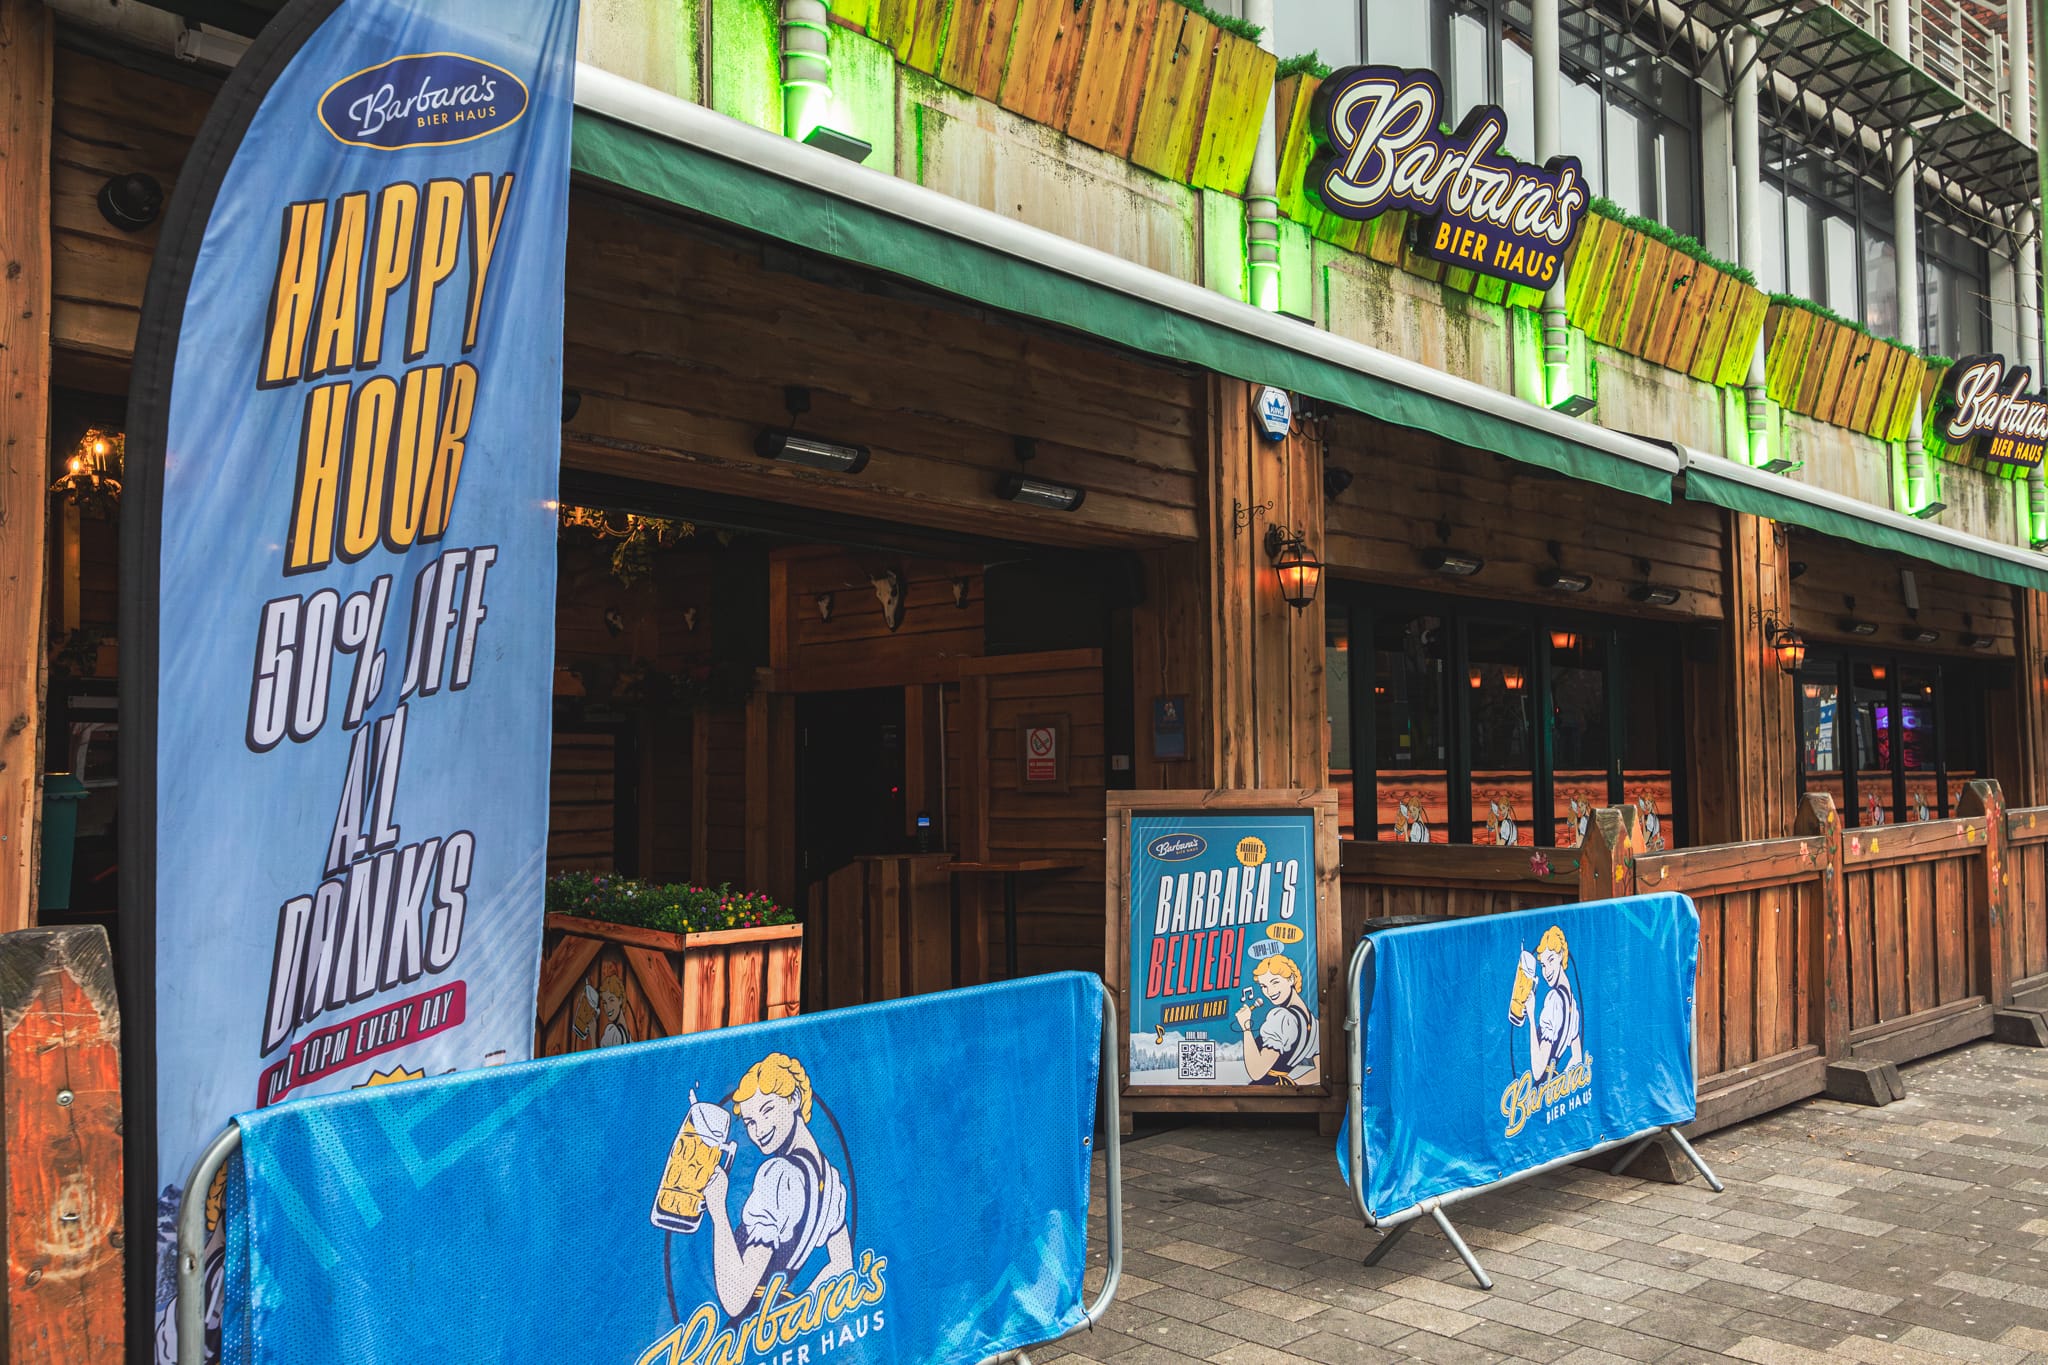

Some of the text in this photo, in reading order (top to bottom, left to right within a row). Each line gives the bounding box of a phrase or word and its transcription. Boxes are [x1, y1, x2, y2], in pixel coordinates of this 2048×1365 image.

[349, 75, 497, 136] Barbara's
[417, 106, 497, 128] BIER HAUS
[1326, 79, 1583, 244] Barbara's
[257, 172, 515, 390] HAPPY
[1435, 222, 1558, 281] BIER HAUS
[1947, 361, 2048, 440] Barbara
[283, 361, 478, 576] HOUR
[1990, 437, 2043, 463] BIER HAUS
[245, 574, 393, 753] 50%
[1155, 838, 1199, 857] Barbara's
[1153, 859, 1299, 935] BARBARA'S
[1145, 927, 1245, 999] BELTER!
[299, 990, 454, 1075] 10PM EVERY DAY
[1163, 999, 1227, 1024] KARAOKE NIGHT
[1501, 1050, 1593, 1138] Barbara's
[1546, 1088, 1593, 1124] BIER HAUS
[634, 1248, 888, 1365] Barbara's
[757, 1309, 885, 1365] ER HAUS
